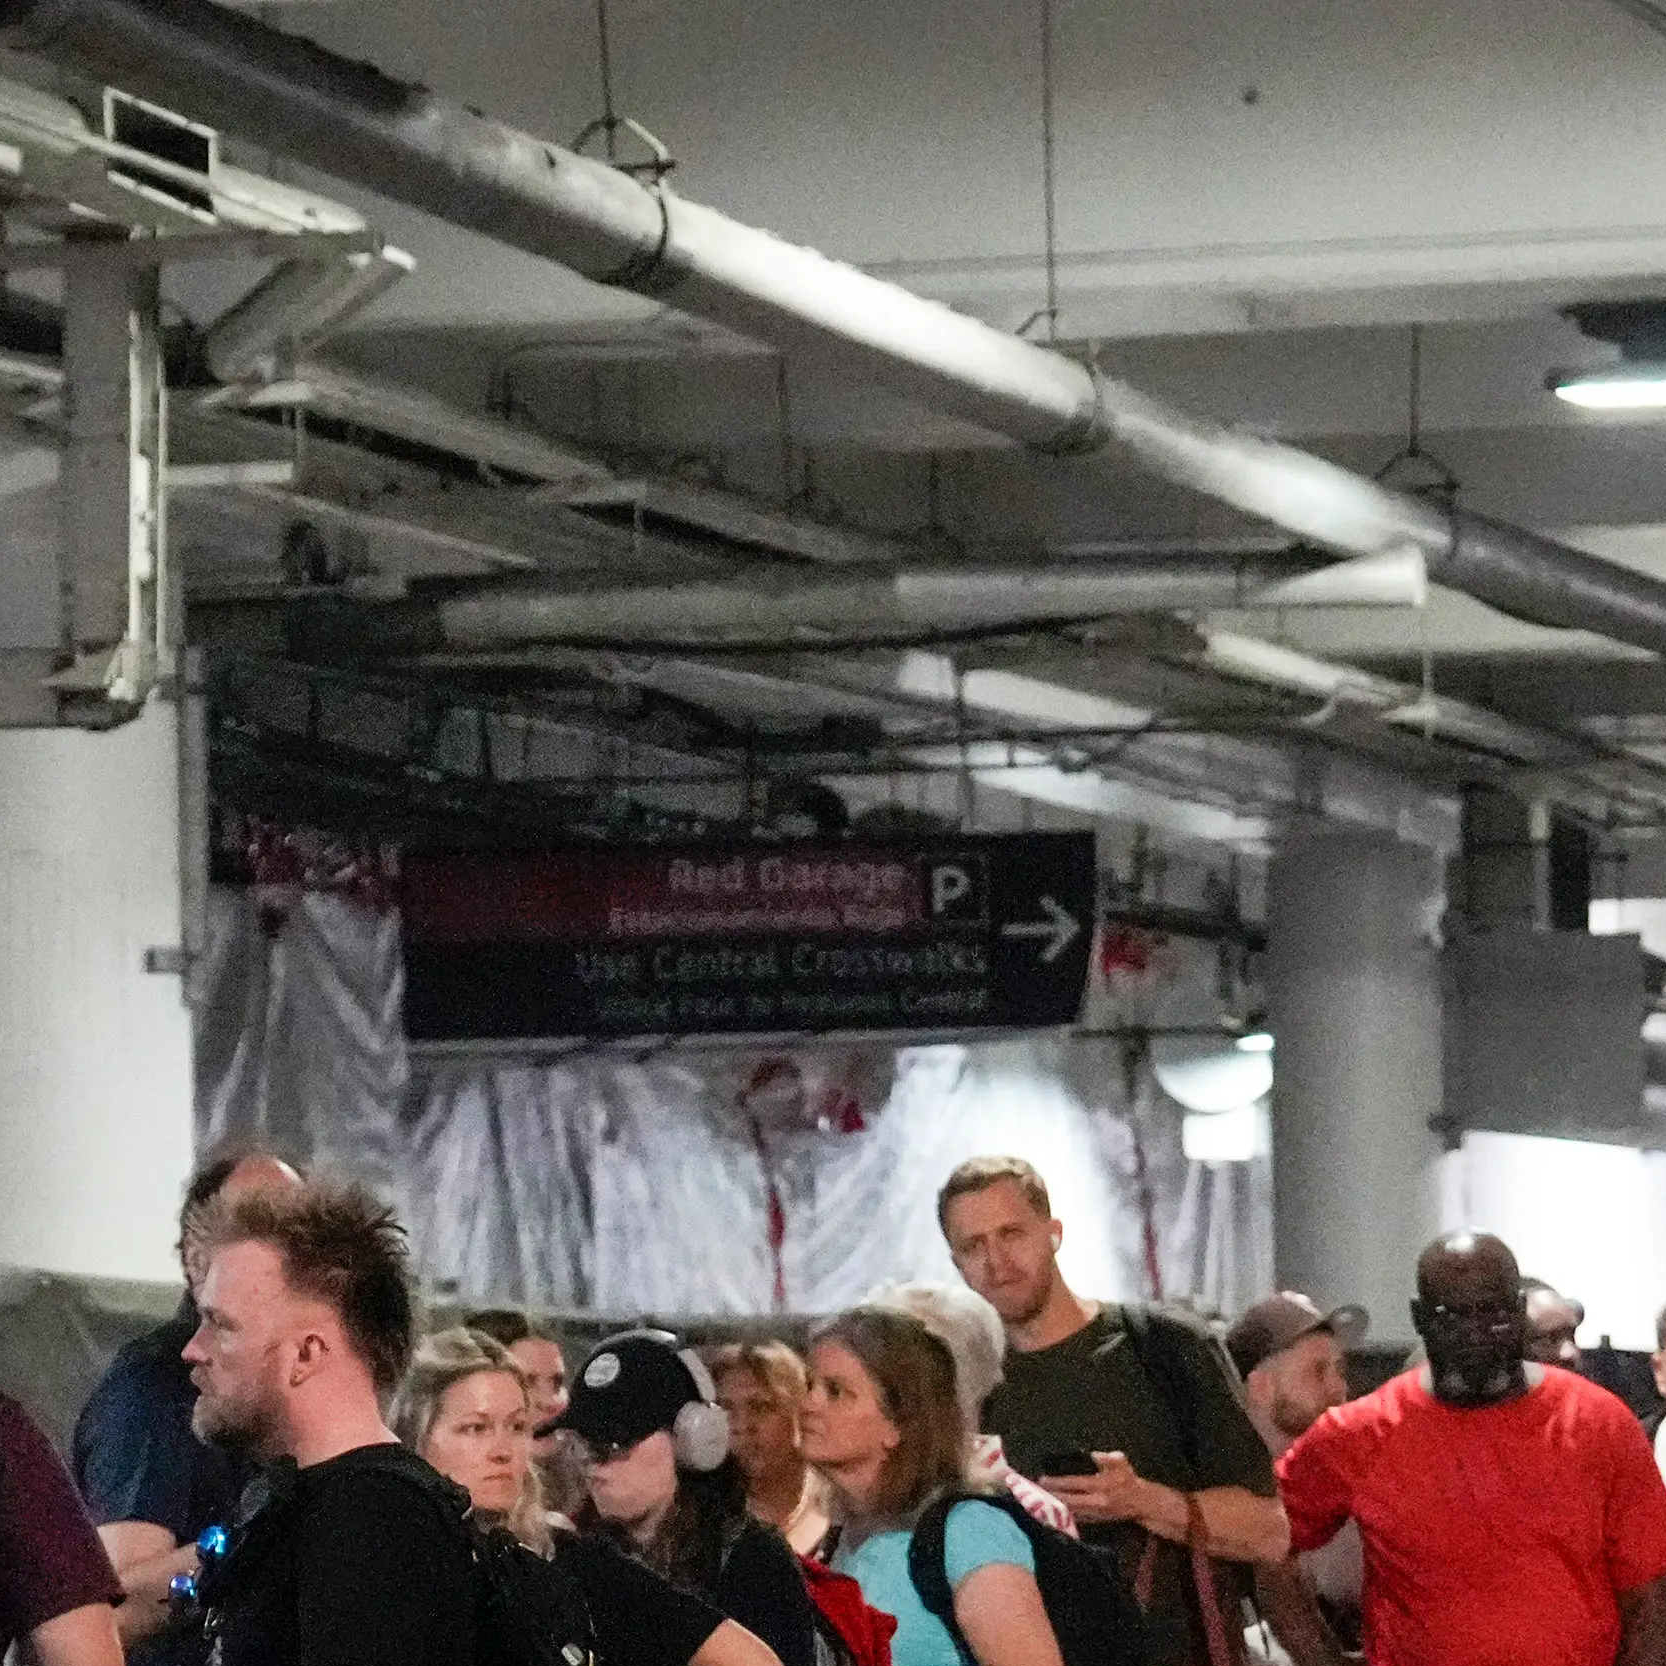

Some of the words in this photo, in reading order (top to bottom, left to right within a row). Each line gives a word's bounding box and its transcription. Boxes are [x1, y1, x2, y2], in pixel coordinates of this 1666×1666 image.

[669, 857, 745, 891] Red
[759, 858, 905, 896] Garage
[932, 867, 970, 913] P
